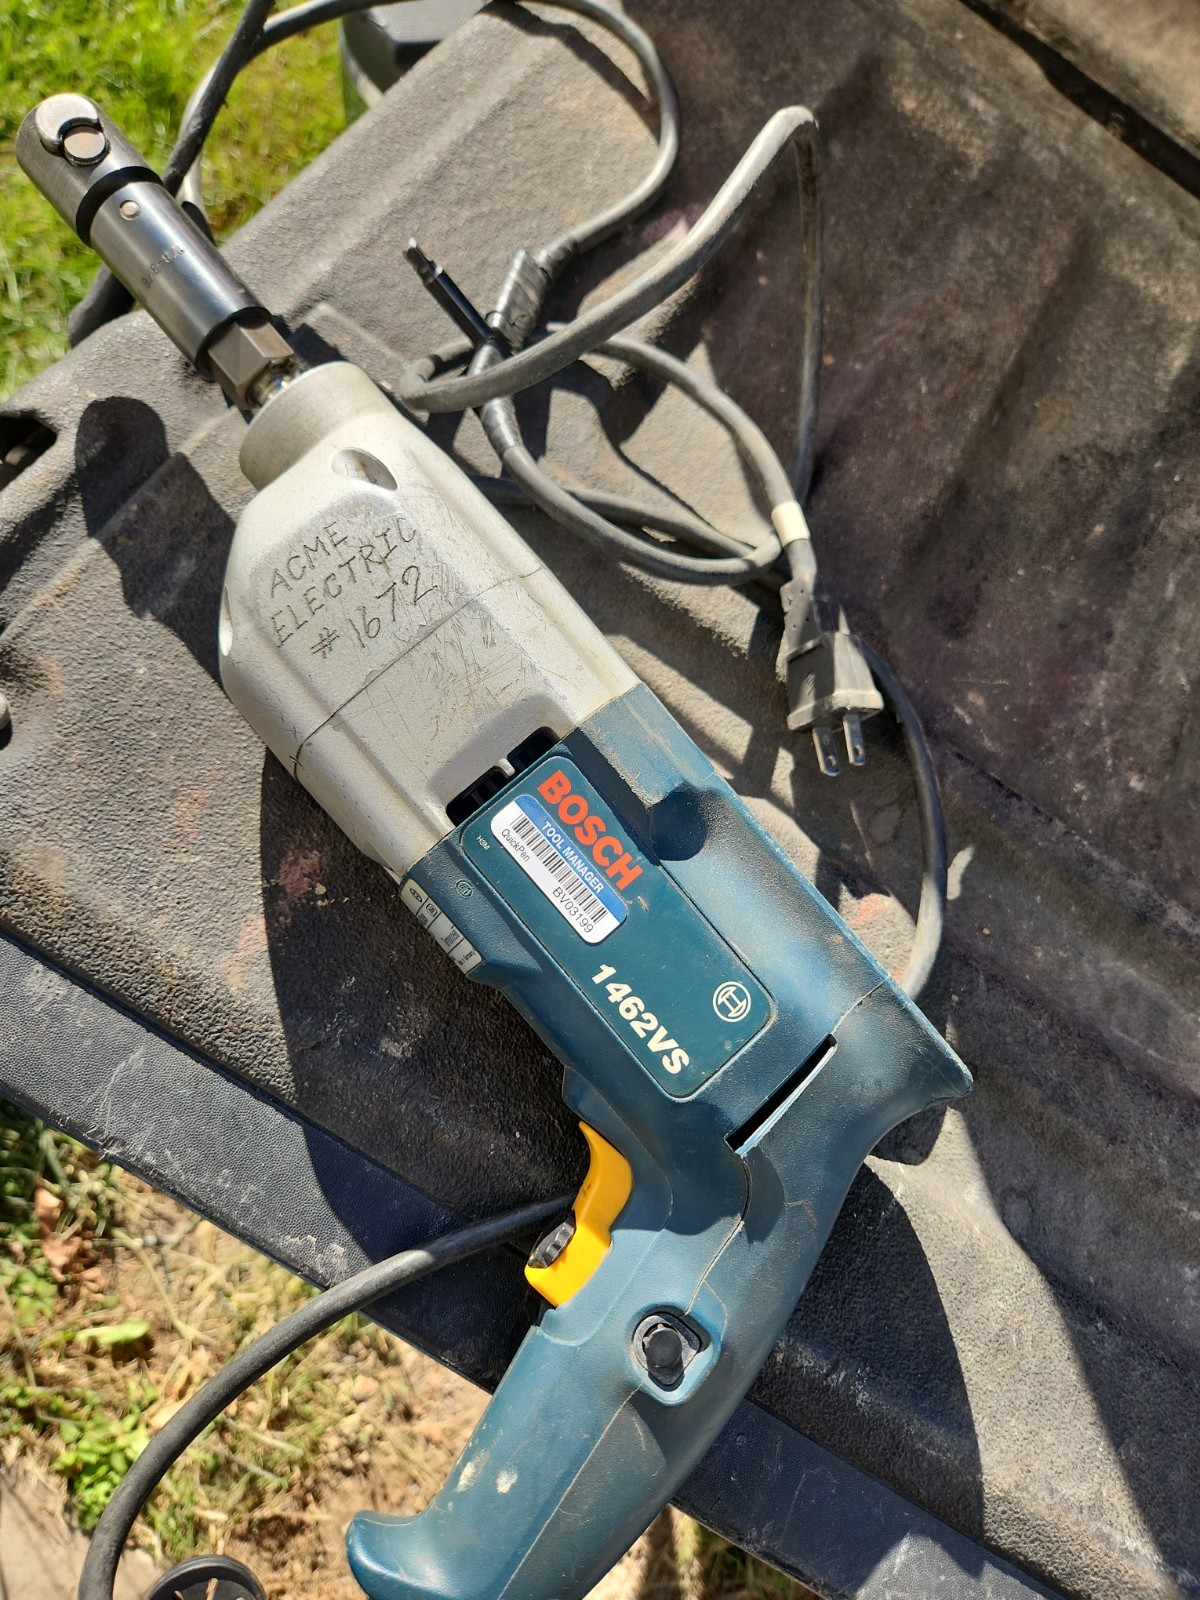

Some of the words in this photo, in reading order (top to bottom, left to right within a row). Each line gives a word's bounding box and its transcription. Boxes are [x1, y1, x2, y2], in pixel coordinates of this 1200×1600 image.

[270, 521, 348, 598] ACME
[270, 517, 416, 648] ELECTRIC
[501, 828, 531, 863] QuickPen
[536, 769, 644, 891] BOSCH
[541, 820, 565, 850] TOOL
[562, 846, 605, 894] MANAGER
[552, 886, 594, 933] BV03199
[591, 963, 690, 1075] 1462VS
